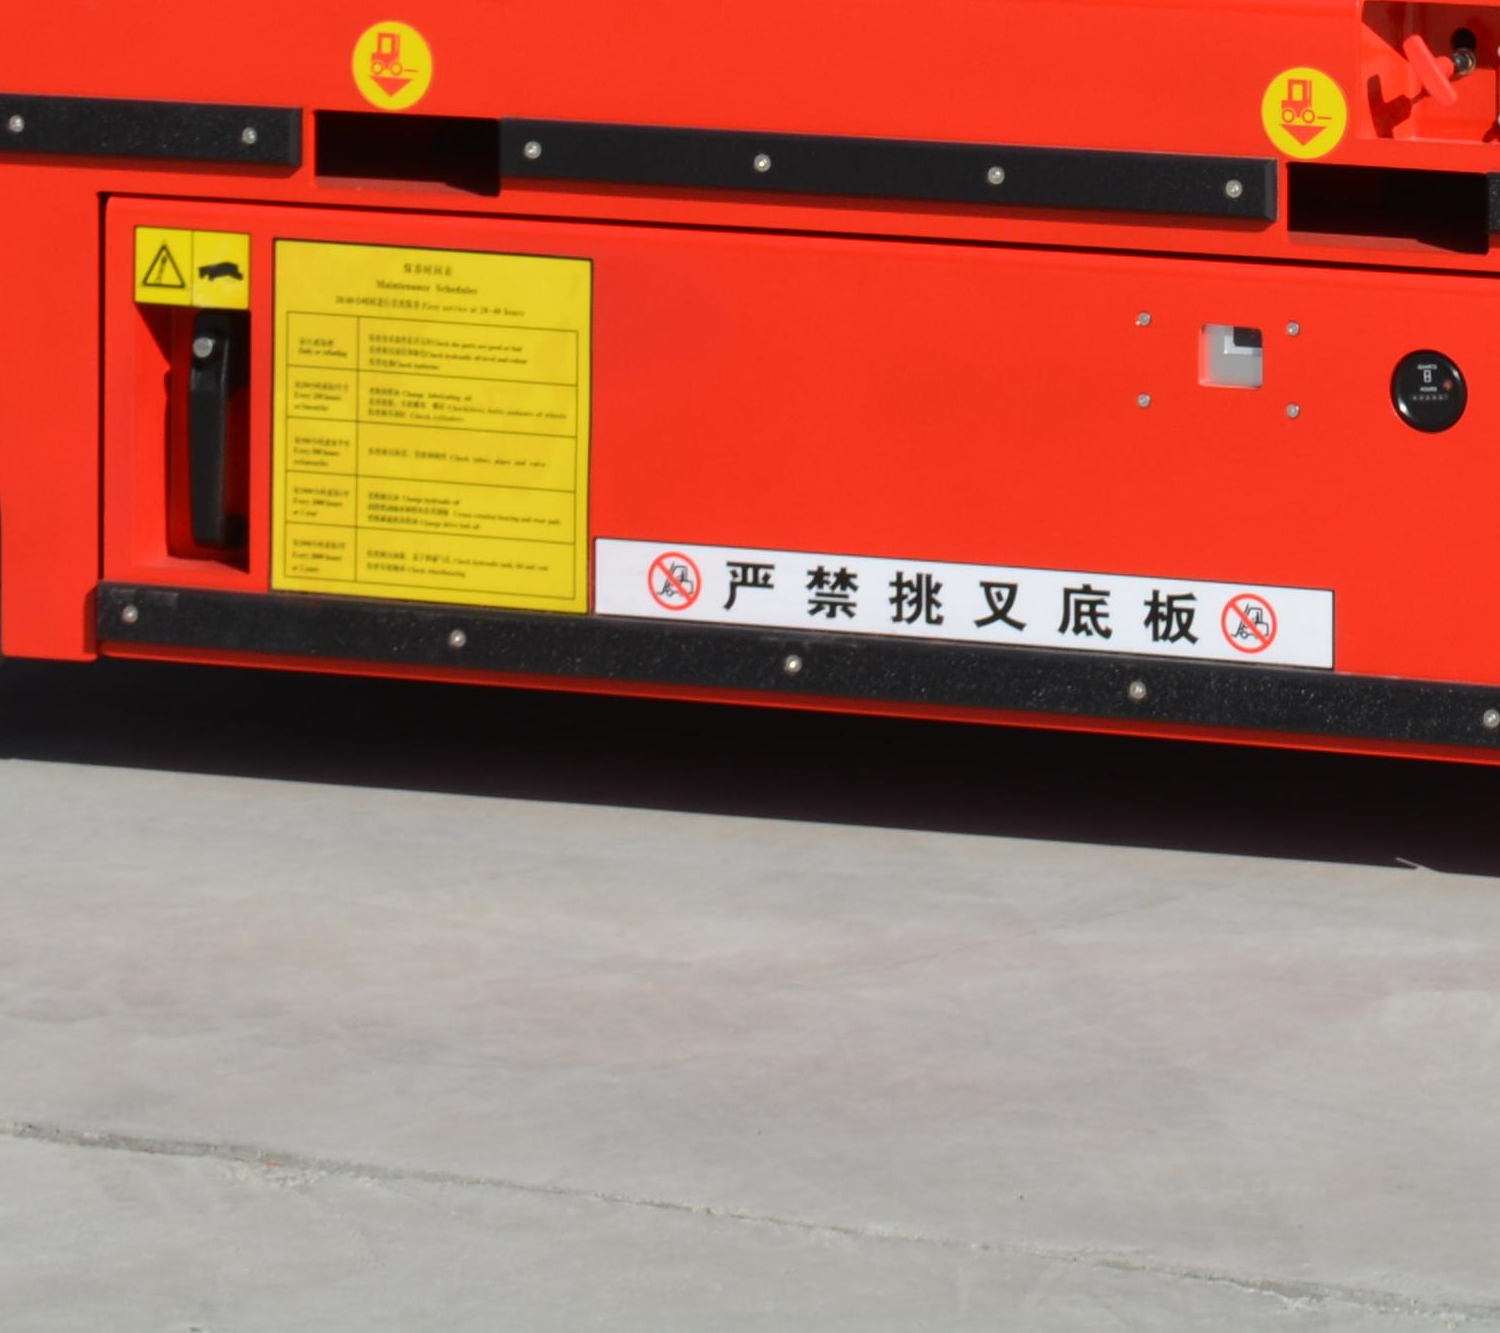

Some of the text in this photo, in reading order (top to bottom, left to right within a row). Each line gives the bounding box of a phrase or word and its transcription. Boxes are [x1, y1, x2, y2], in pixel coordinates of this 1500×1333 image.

[722, 559, 1201, 646] 严禁挑叉底板
